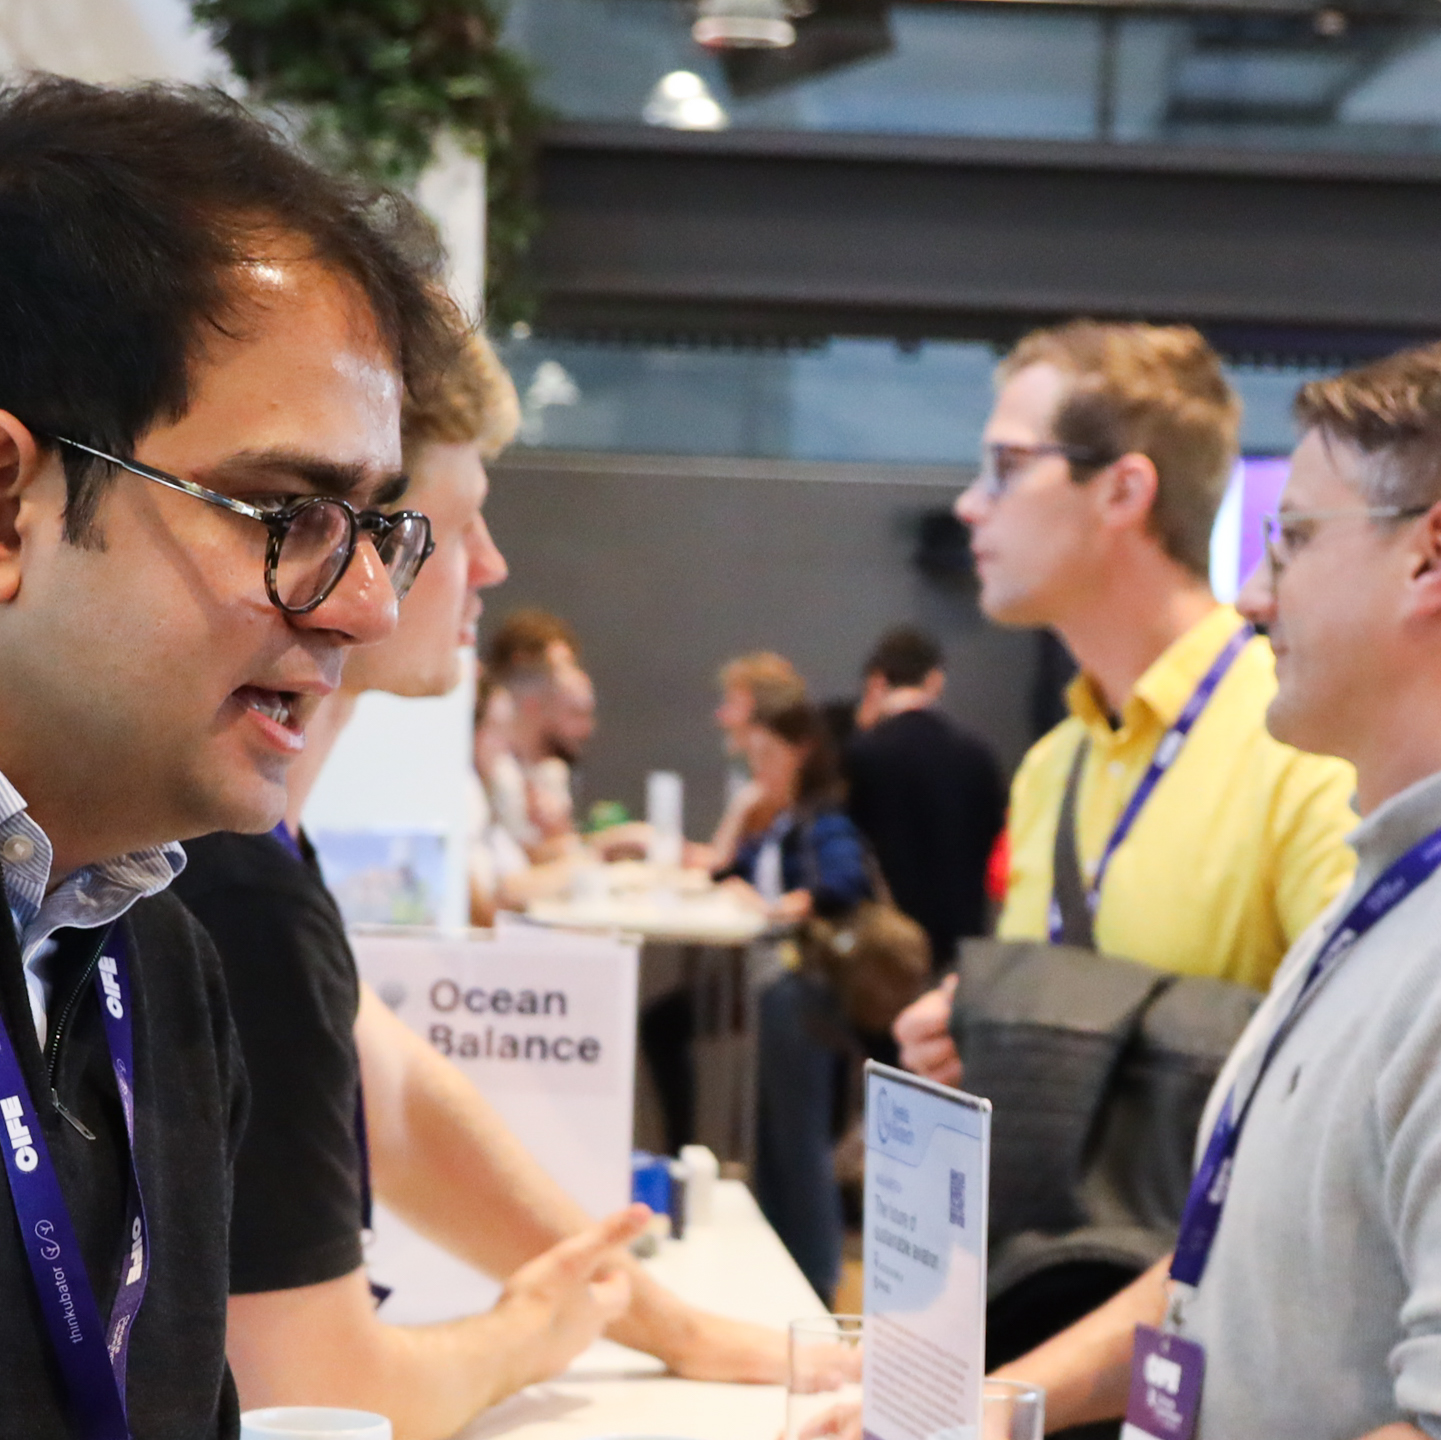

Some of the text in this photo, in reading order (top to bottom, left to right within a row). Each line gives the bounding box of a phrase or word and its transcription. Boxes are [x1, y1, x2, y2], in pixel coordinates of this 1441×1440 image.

[428, 978, 568, 1016] Ocean
[428, 1024, 601, 1063] Balance
[52, 1266, 83, 1345] thinkubator
